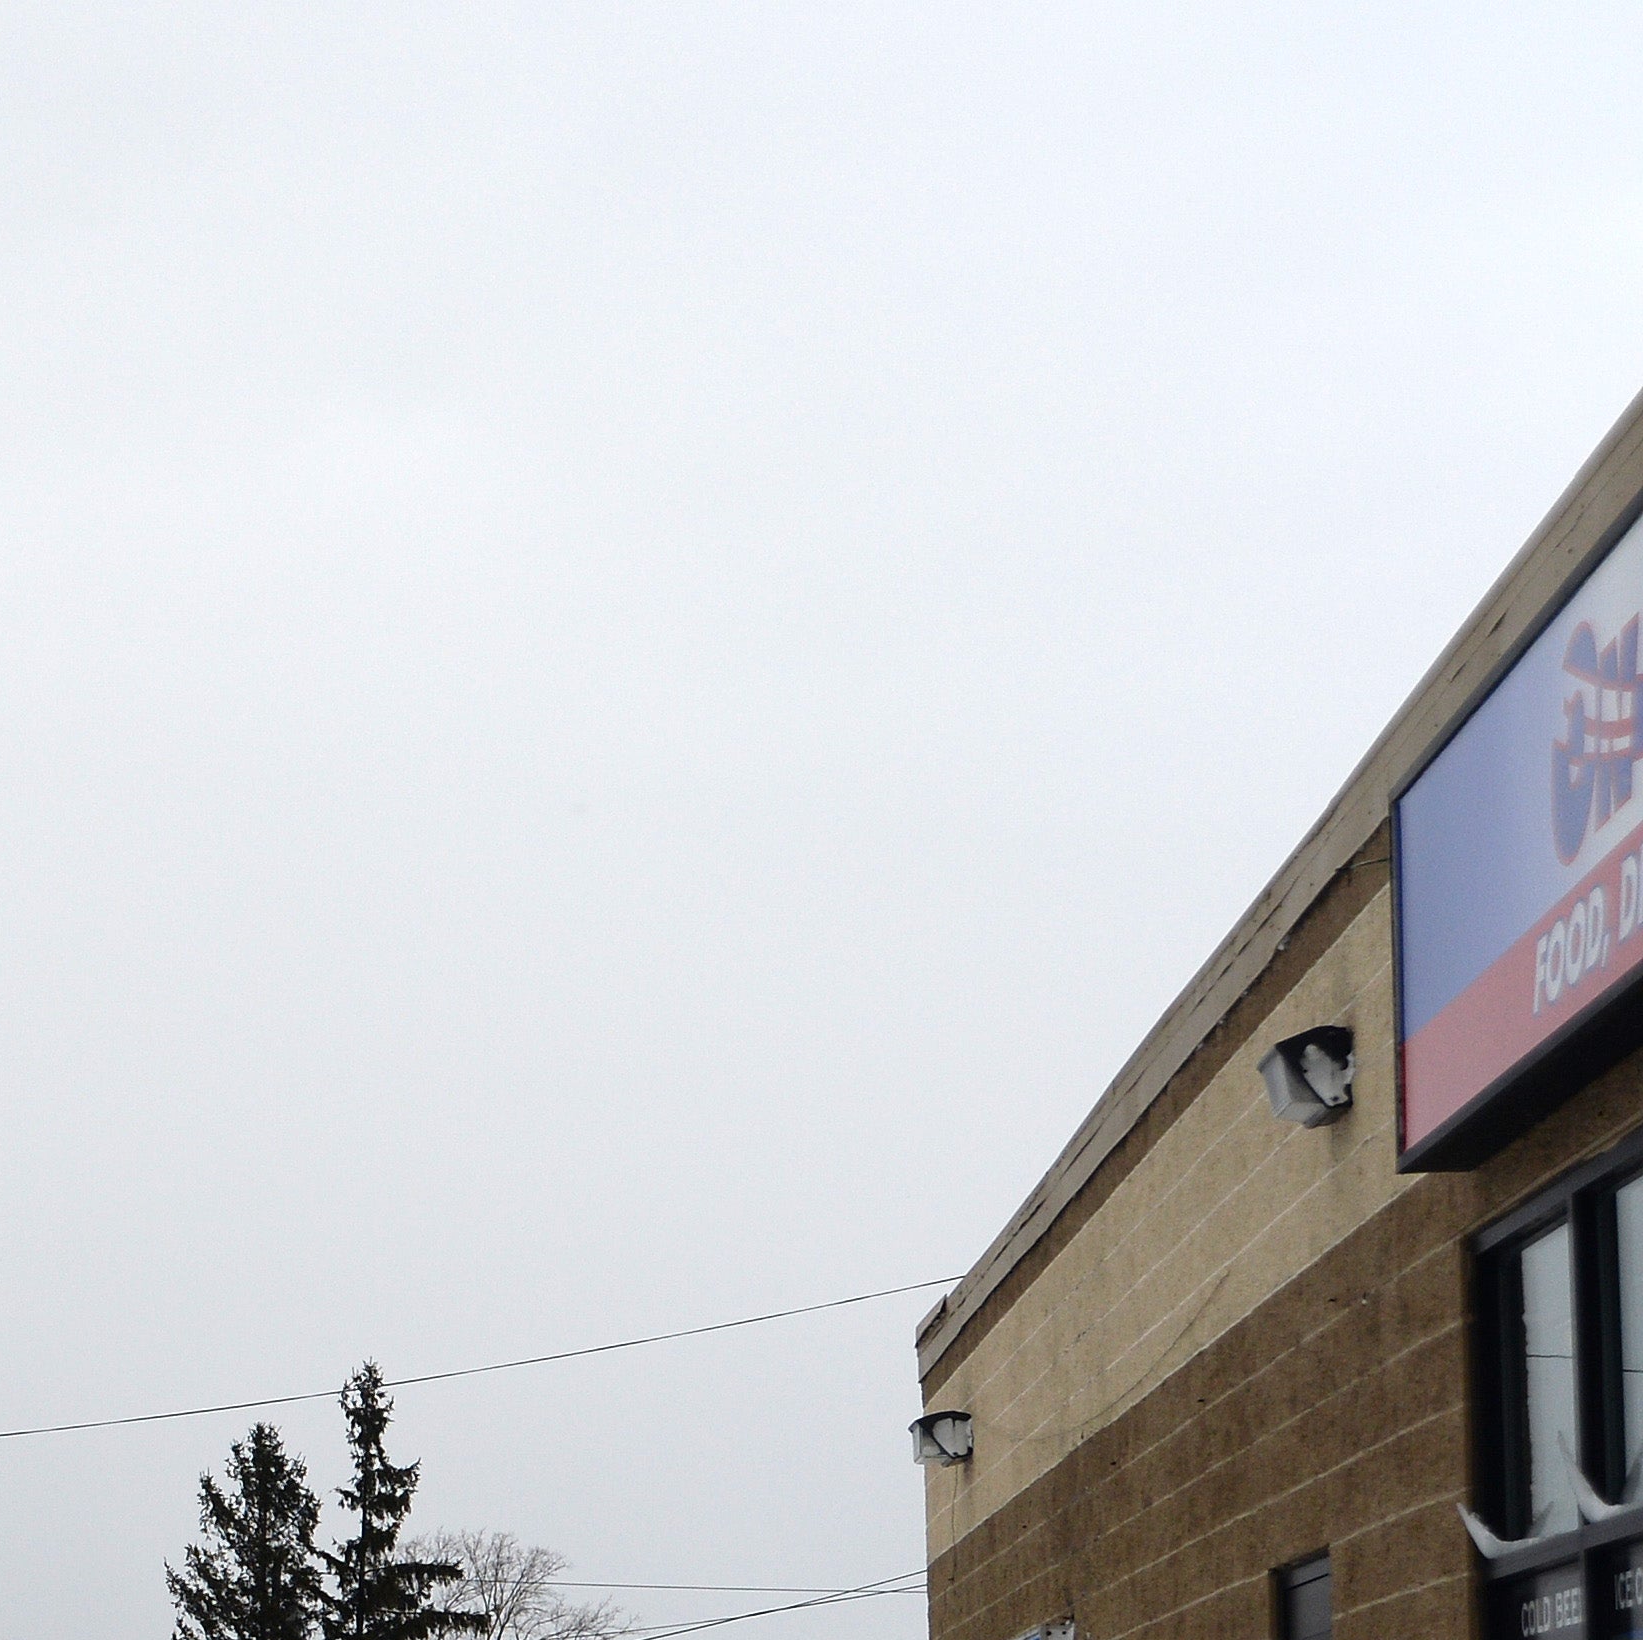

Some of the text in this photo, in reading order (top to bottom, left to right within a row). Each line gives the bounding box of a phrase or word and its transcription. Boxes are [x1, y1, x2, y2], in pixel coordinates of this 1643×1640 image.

[1533, 842, 1643, 1014] FOOD, D
[1521, 1586, 1582, 1638] COLD BEE
